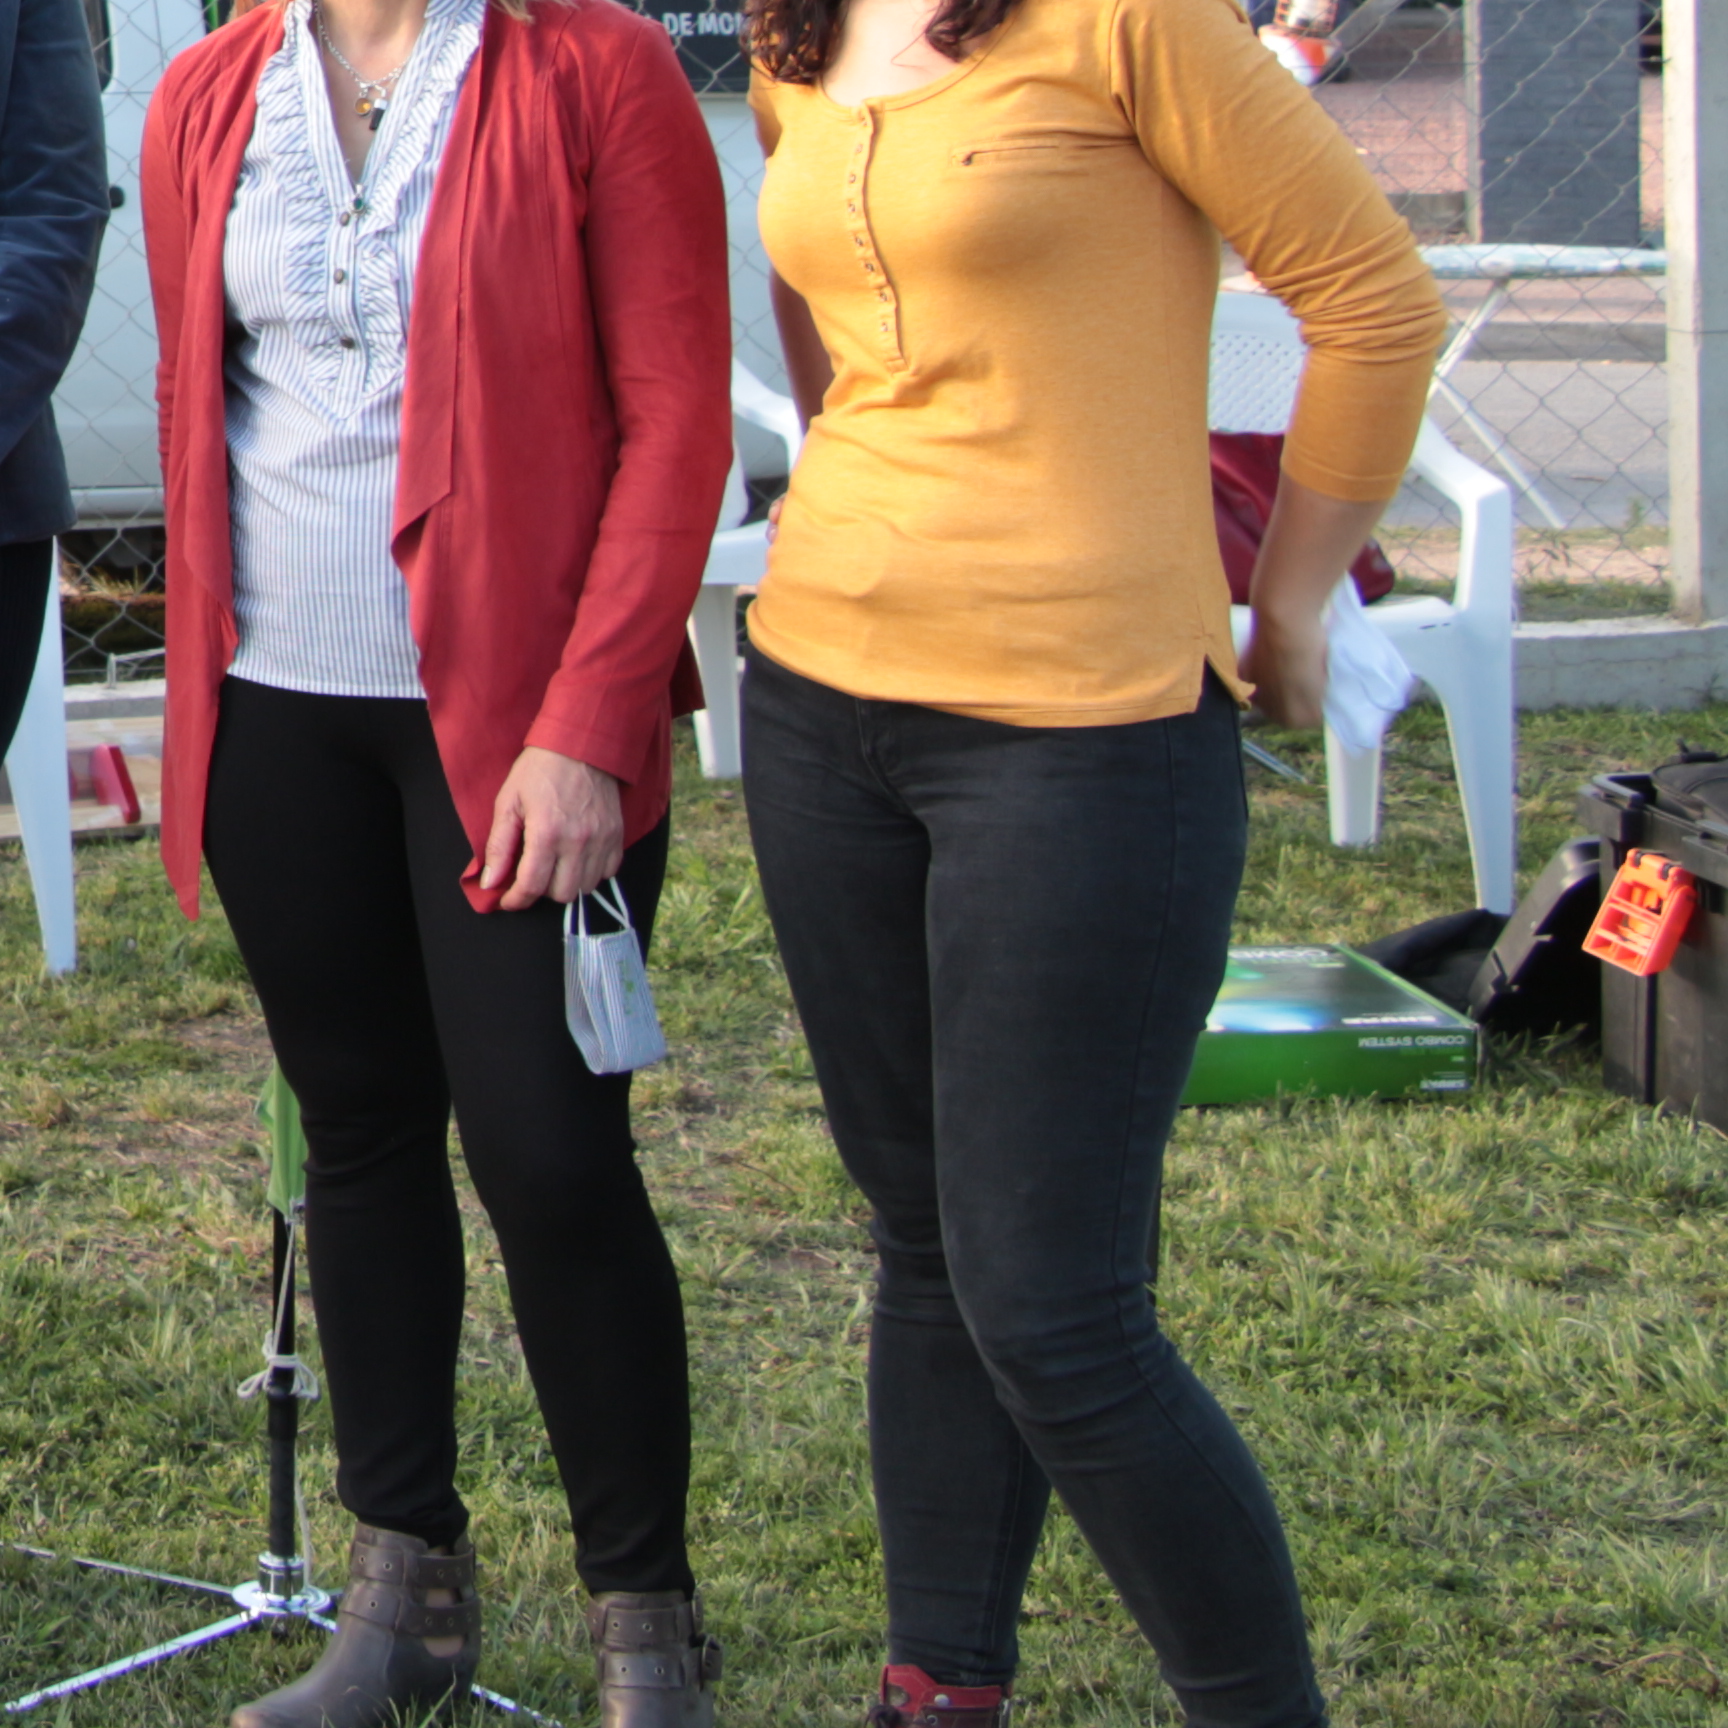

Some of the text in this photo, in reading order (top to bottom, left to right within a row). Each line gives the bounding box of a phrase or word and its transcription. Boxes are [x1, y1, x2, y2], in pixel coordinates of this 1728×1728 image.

[662, 12, 694, 36] DE
[1358, 1035, 1466, 1048] COMBO SYSTEM
